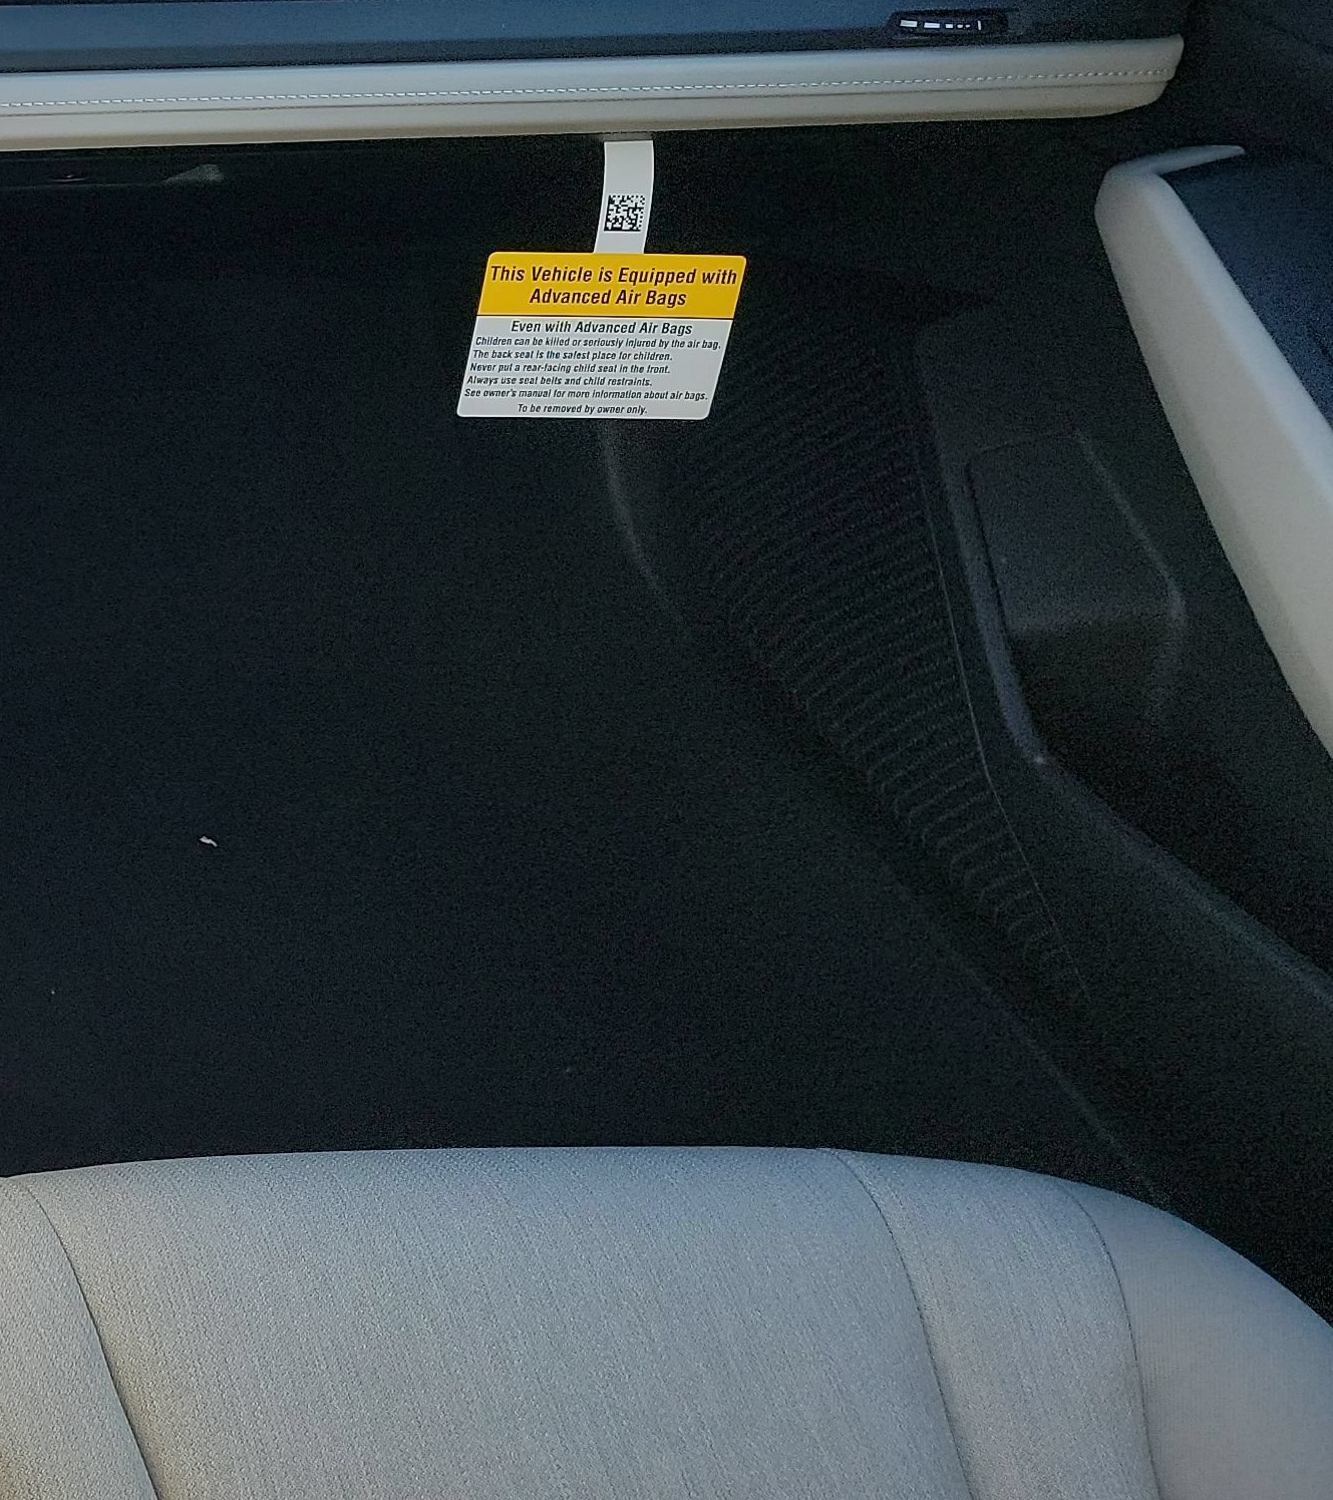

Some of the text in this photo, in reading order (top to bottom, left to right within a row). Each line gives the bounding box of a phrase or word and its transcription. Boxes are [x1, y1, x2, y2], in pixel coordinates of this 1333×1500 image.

[491, 266, 737, 286] This Vehicle is Equipped with
[529, 288, 687, 308] Advanced Air Bags
[511, 320, 693, 336] Even with Advanced Air Bags
[475, 337, 512, 346] Children
[532, 337, 544, 346] be
[545, 338, 570, 347] killed
[583, 338, 625, 348] seriously
[625, 338, 657, 348] injured
[658, 338, 670, 349] by
[671, 339, 685, 348] the
[687, 339, 701, 349] air
[702, 340, 721, 351] bag.
[473, 350, 673, 362] The back seat is the safest place for children.
[469, 363, 496, 372] Never
[498, 363, 513, 373] put
[523, 364, 572, 374] rear-facing
[573, 364, 596, 373] child
[597, 364, 617, 373] seat
[619, 364, 629, 373] in
[630, 365, 645, 374] the
[646, 365, 671, 374] front.
[467, 376, 653, 387] Always use seat belts and child restraints.
[464, 388, 708, 402] See owner's manual for more information about air bags.
[518, 403, 648, 415] To be removed by owner only.
